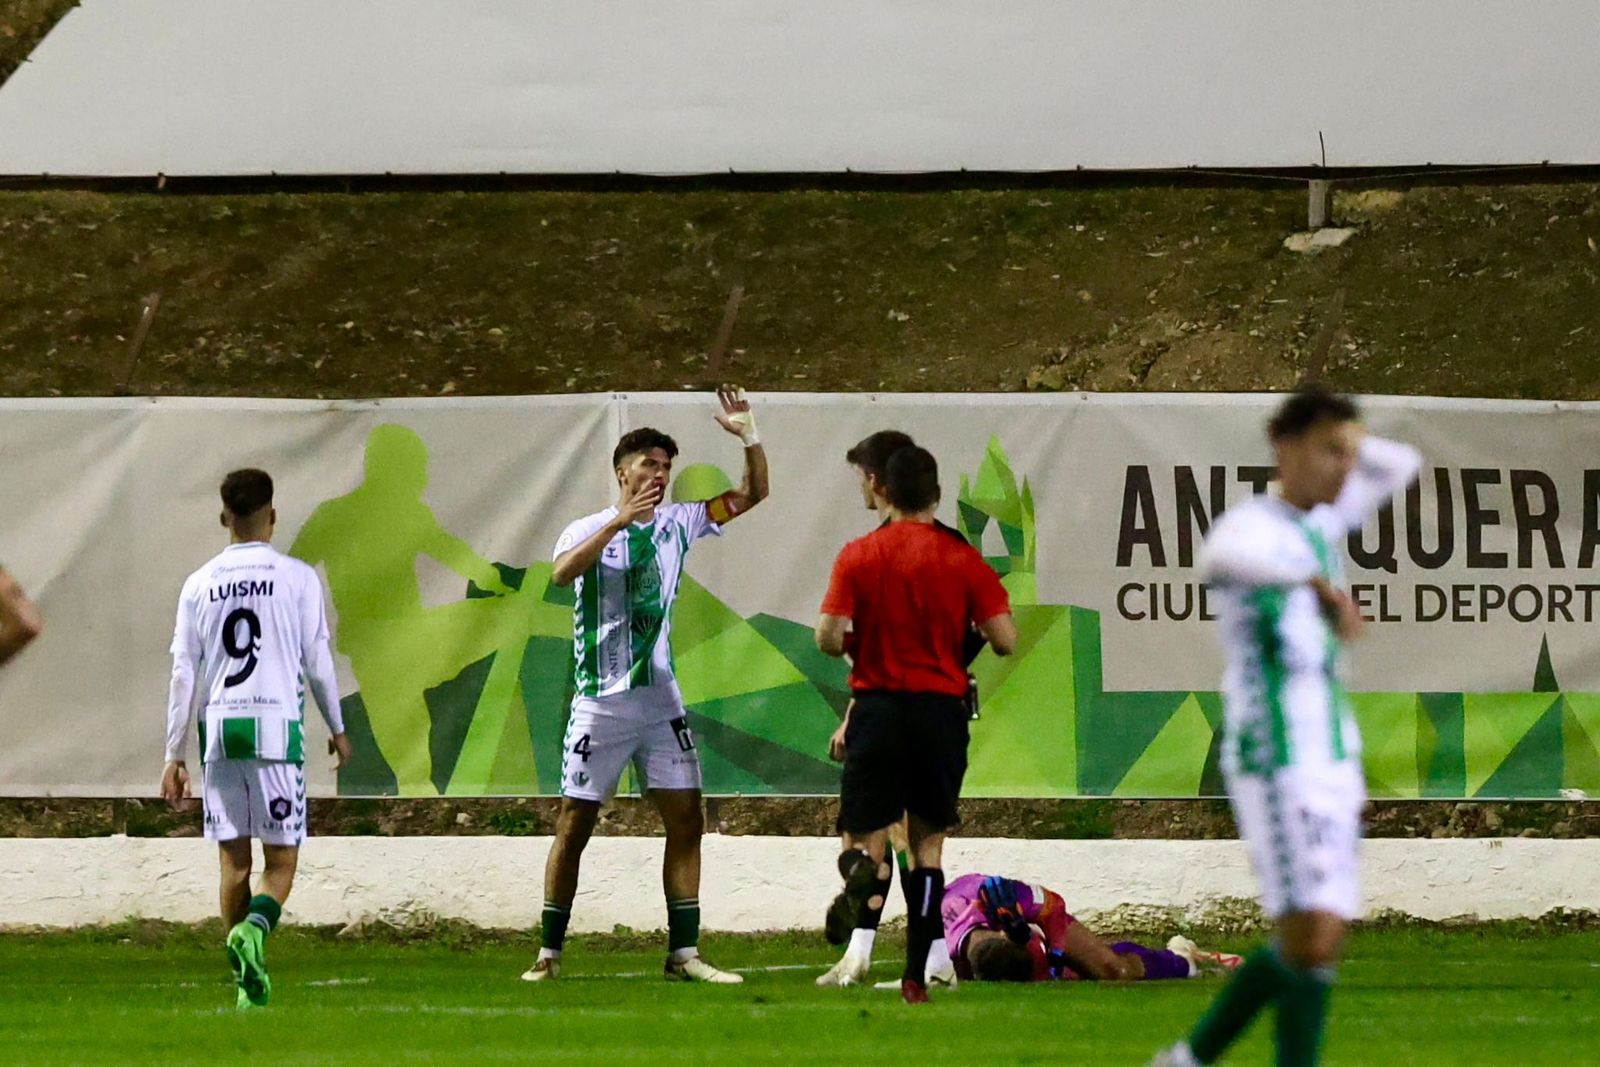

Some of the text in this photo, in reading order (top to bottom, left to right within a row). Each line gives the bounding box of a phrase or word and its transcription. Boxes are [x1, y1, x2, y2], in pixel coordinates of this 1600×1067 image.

[1116, 465, 1600, 574] ANQUER
[209, 580, 274, 603] LUISMI
[1350, 584, 1402, 622] EL
[222, 607, 262, 689] 9
[573, 733, 592, 763] 4
